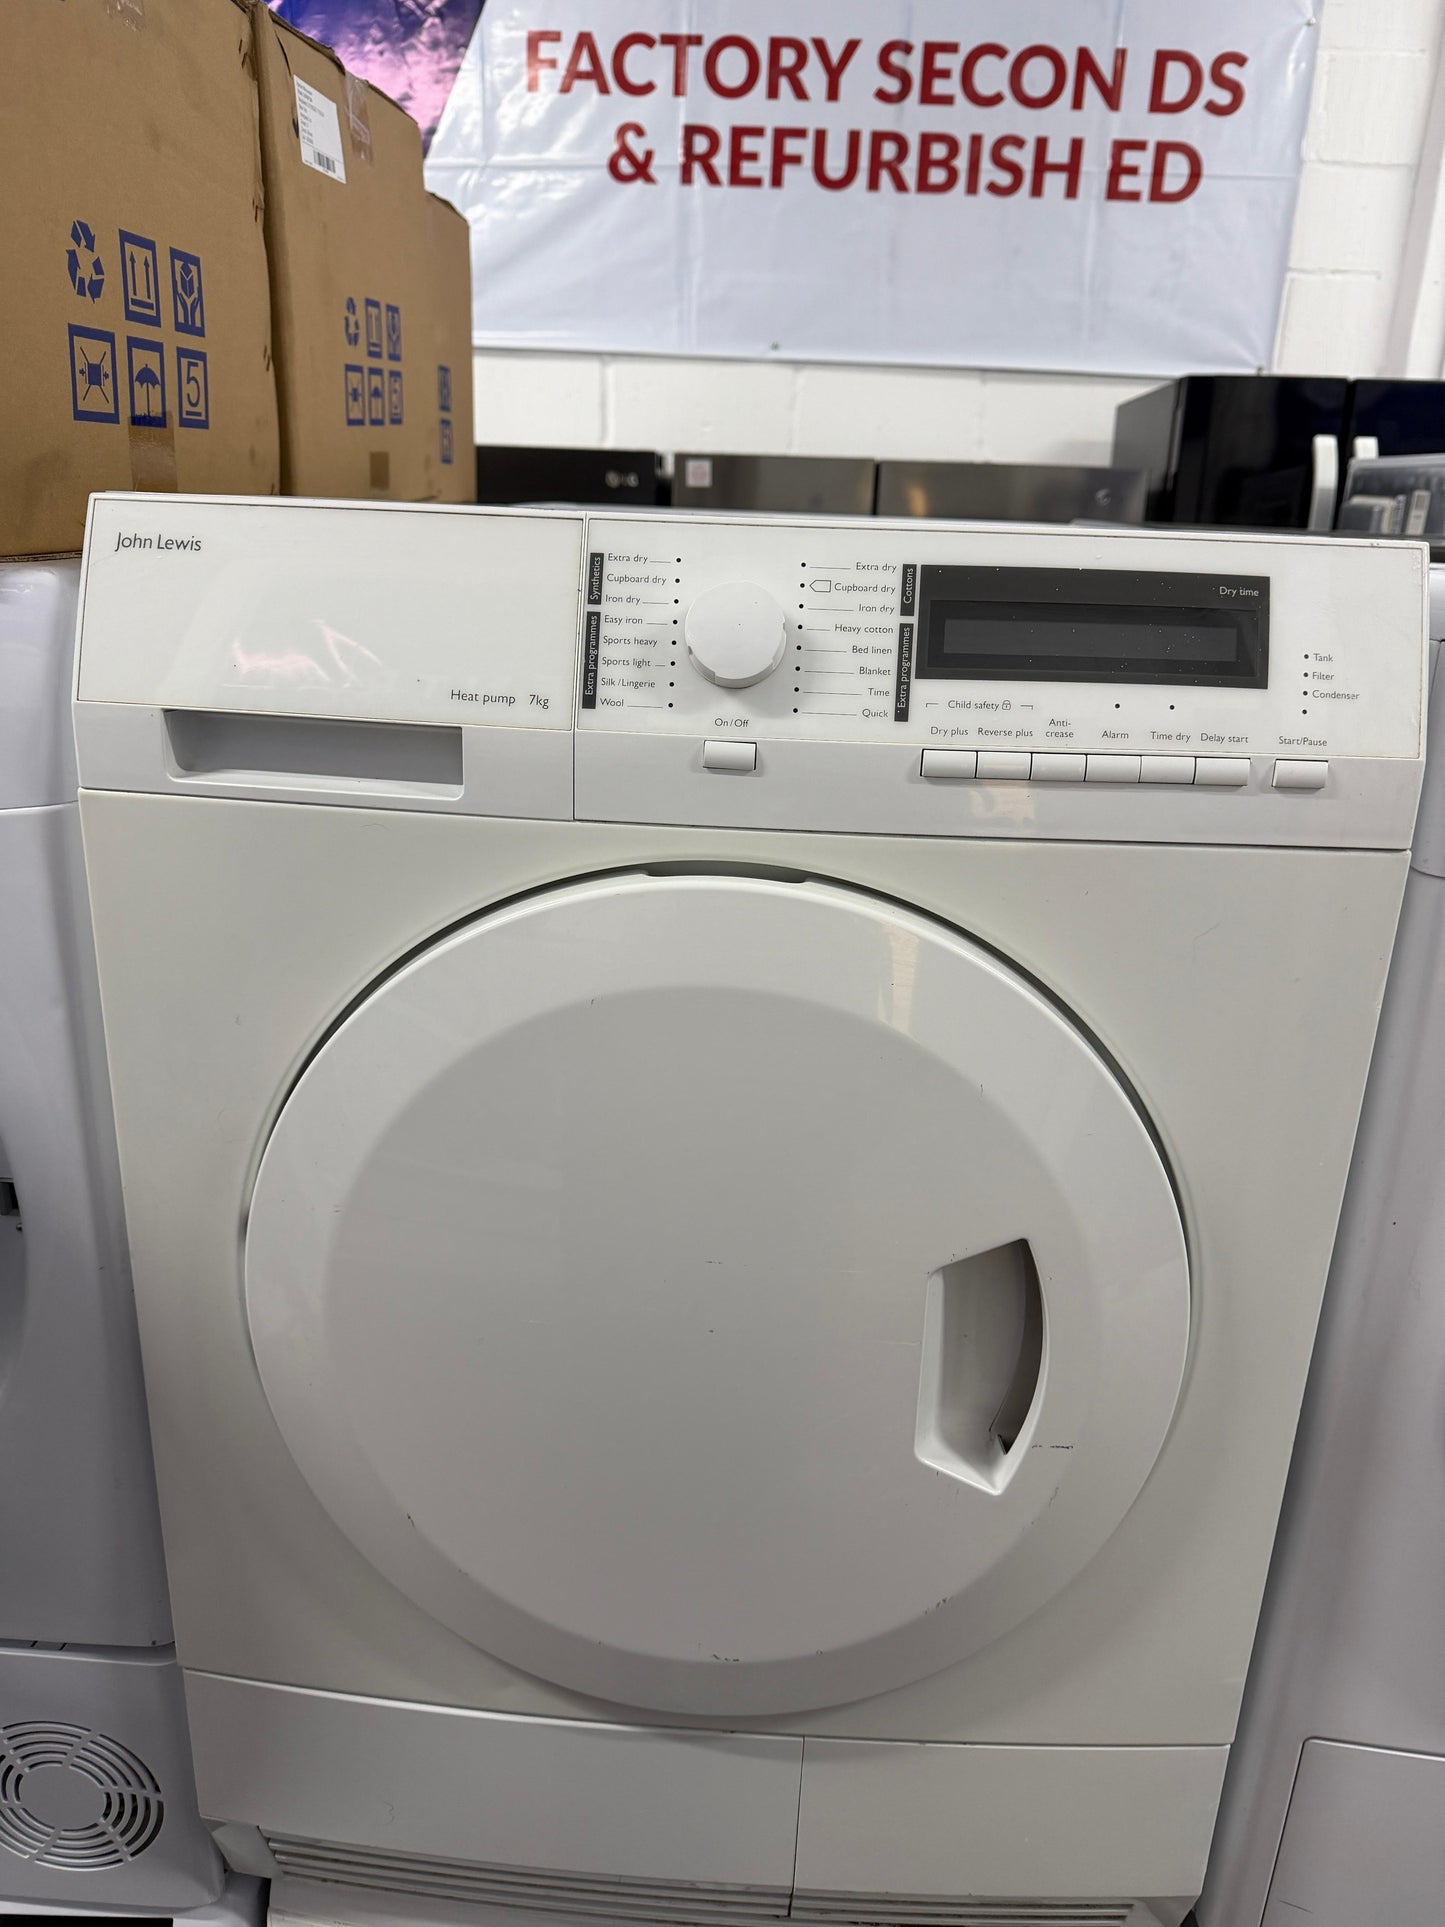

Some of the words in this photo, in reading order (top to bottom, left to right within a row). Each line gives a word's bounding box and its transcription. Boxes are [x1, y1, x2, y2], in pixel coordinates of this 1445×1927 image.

[526, 31, 861, 102] FACTORY
[609, 122, 656, 187] &
[185, 361, 201, 409] 5
[115, 532, 152, 552] John
[157, 534, 201, 551] Lewis
[608, 554, 630, 563] Extra
[633, 554, 648, 564] dry
[856, 563, 878, 572] Extra
[881, 563, 897, 573] dry
[590, 557, 601, 600] Synthetics
[607, 574, 649, 585] Cupboard
[652, 575, 667, 585] dry
[834, 583, 878, 594] Cupboard
[881, 584, 896, 594] dry
[903, 568, 913, 604] Cottons
[1219, 586, 1236, 598] Dry
[1239, 587, 1259, 597] time
[605, 595, 622, 604] Iron
[625, 595, 641, 605] dry
[859, 604, 876, 612] Iron
[879, 605, 895, 614] dry
[605, 616, 622, 626] Easy
[625, 616, 643, 624] iron
[835, 624, 862, 634] Heavy
[865, 625, 894, 634] cotton
[586, 615, 597, 669] programmes
[603, 636, 630, 646] Sports
[633, 637, 658, 647] heavy
[852, 646, 869, 654] Bed
[871, 646, 892, 655] linen
[898, 627, 910, 682] programmes
[602, 657, 630, 667] Sports
[632, 658, 651, 668] light
[1313, 653, 1333, 662] Tank
[859, 667, 891, 676] Blanket
[1312, 672, 1334, 680] Filter
[585, 671, 594, 695] Extra
[868, 688, 890, 697] Time
[897, 684, 906, 708] Extra
[1312, 690, 1360, 699] Condenser
[451, 689, 478, 702] Heat
[482, 692, 516, 706] pump
[529, 693, 549, 709] 7kg
[600, 698, 624, 708] Wool
[948, 700, 971, 709] Child
[974, 701, 999, 711] safety
[862, 709, 888, 718] Quick
[1049, 719, 1071, 727] Anti-
[931, 727, 948, 737] Dry
[951, 728, 968, 737] plus
[978, 728, 1012, 737] Reverse
[1016, 729, 1033, 738] plus
[1102, 731, 1129, 739] Alarm
[1150, 731, 1173, 740] Time
[1175, 731, 1191, 742] dry
[1200, 732, 1225, 744] Delay
[1228, 734, 1249, 743] start
[1279, 736, 1327, 747] Start/Pause
